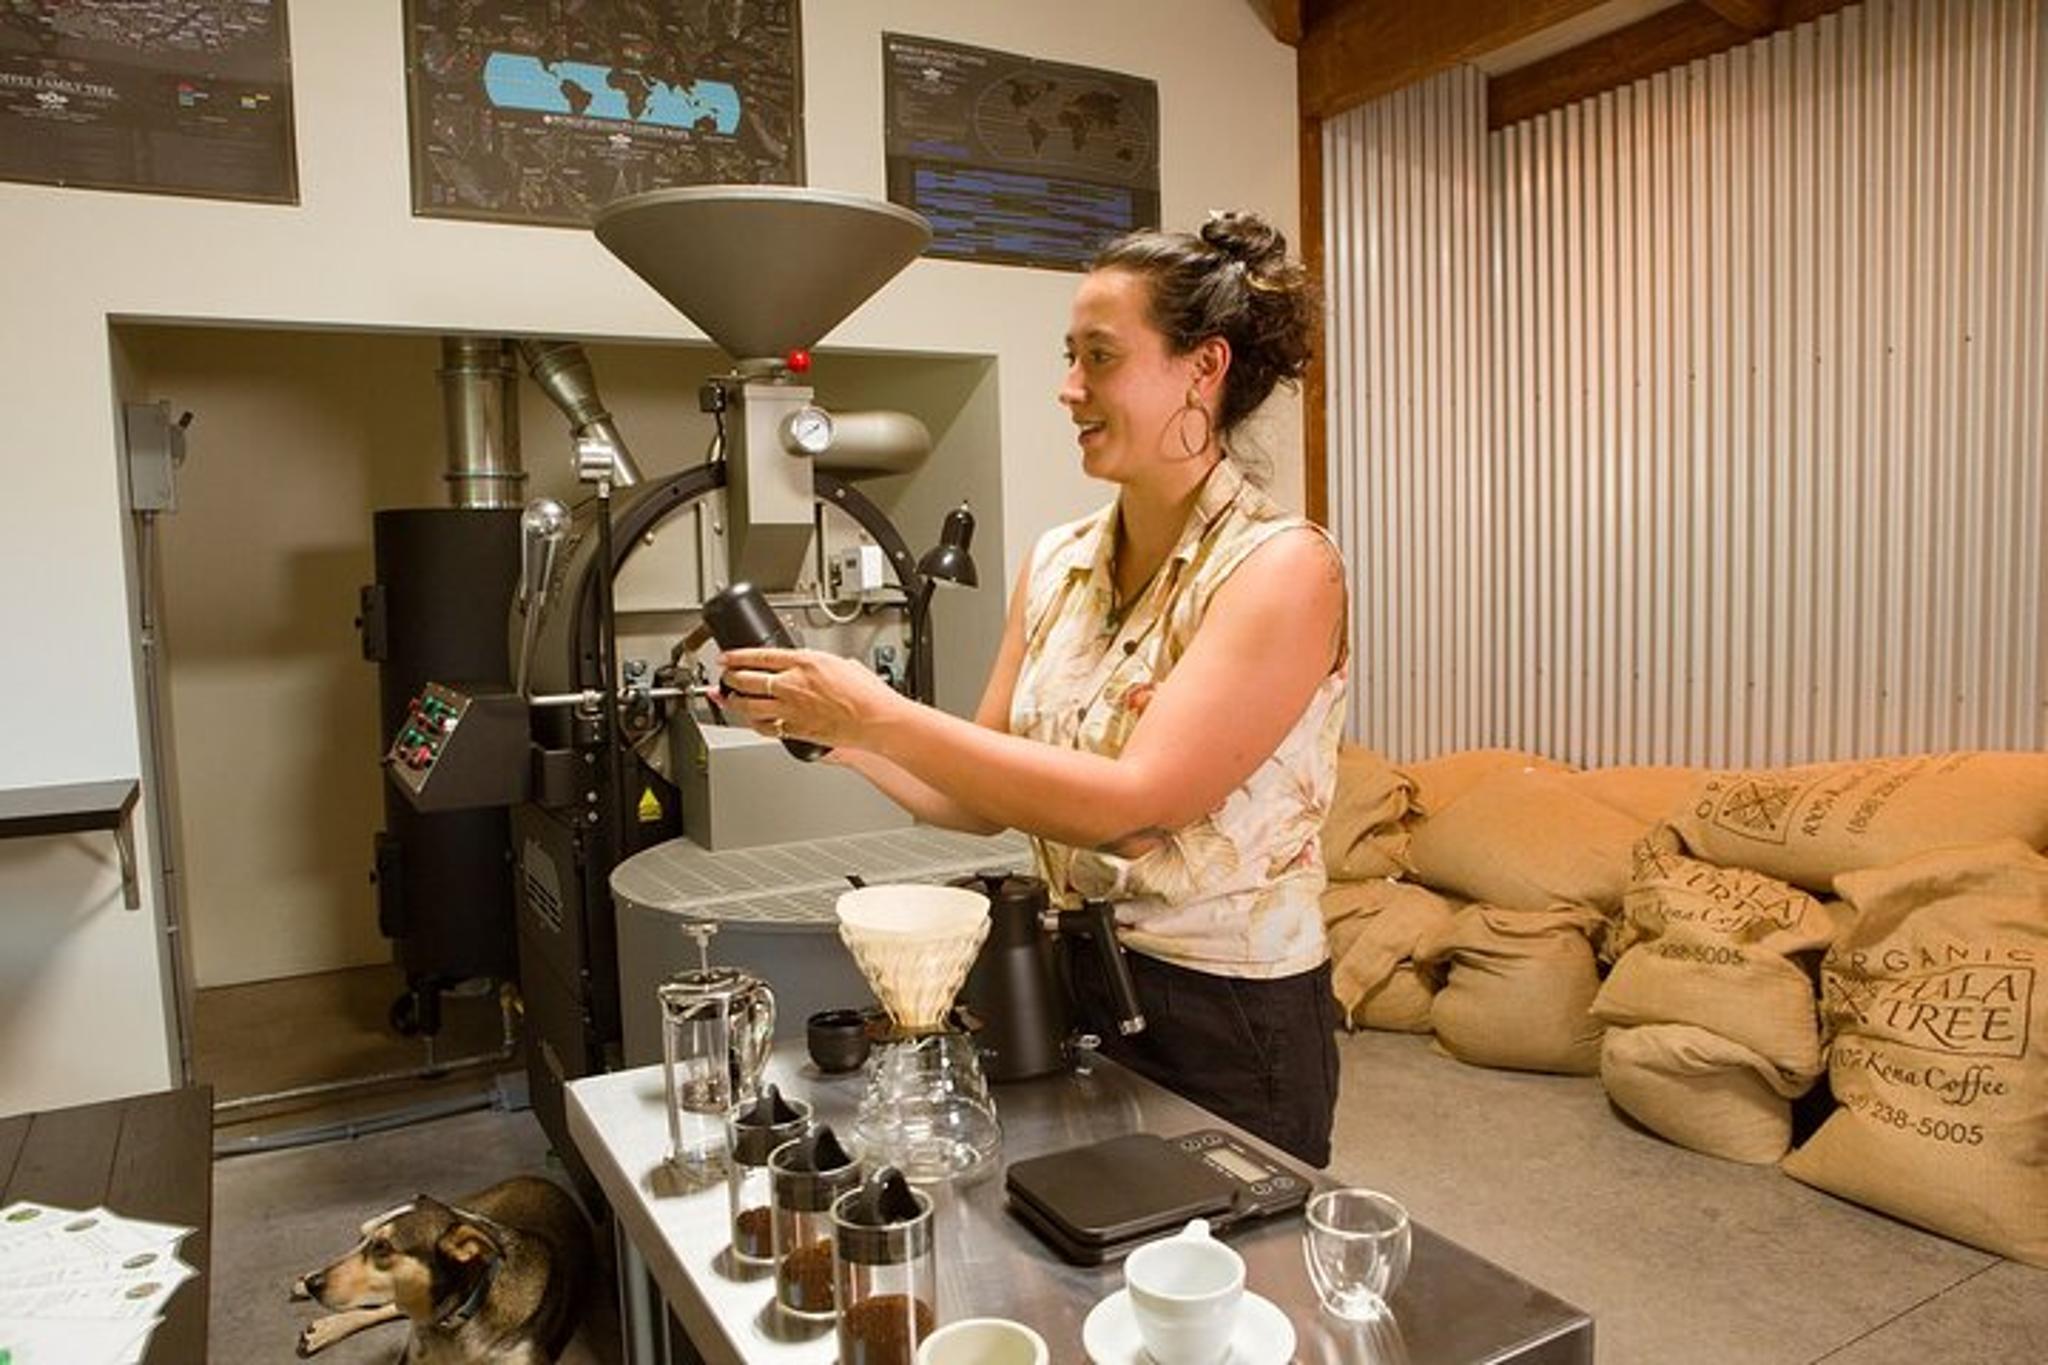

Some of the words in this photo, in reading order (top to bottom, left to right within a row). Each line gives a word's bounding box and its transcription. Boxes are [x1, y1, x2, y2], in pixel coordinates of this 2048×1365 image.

[1880, 998, 2015, 1050] TREE
[1924, 1064, 2006, 1107] Coffee
[1870, 1100, 1985, 1146] 238-5005
